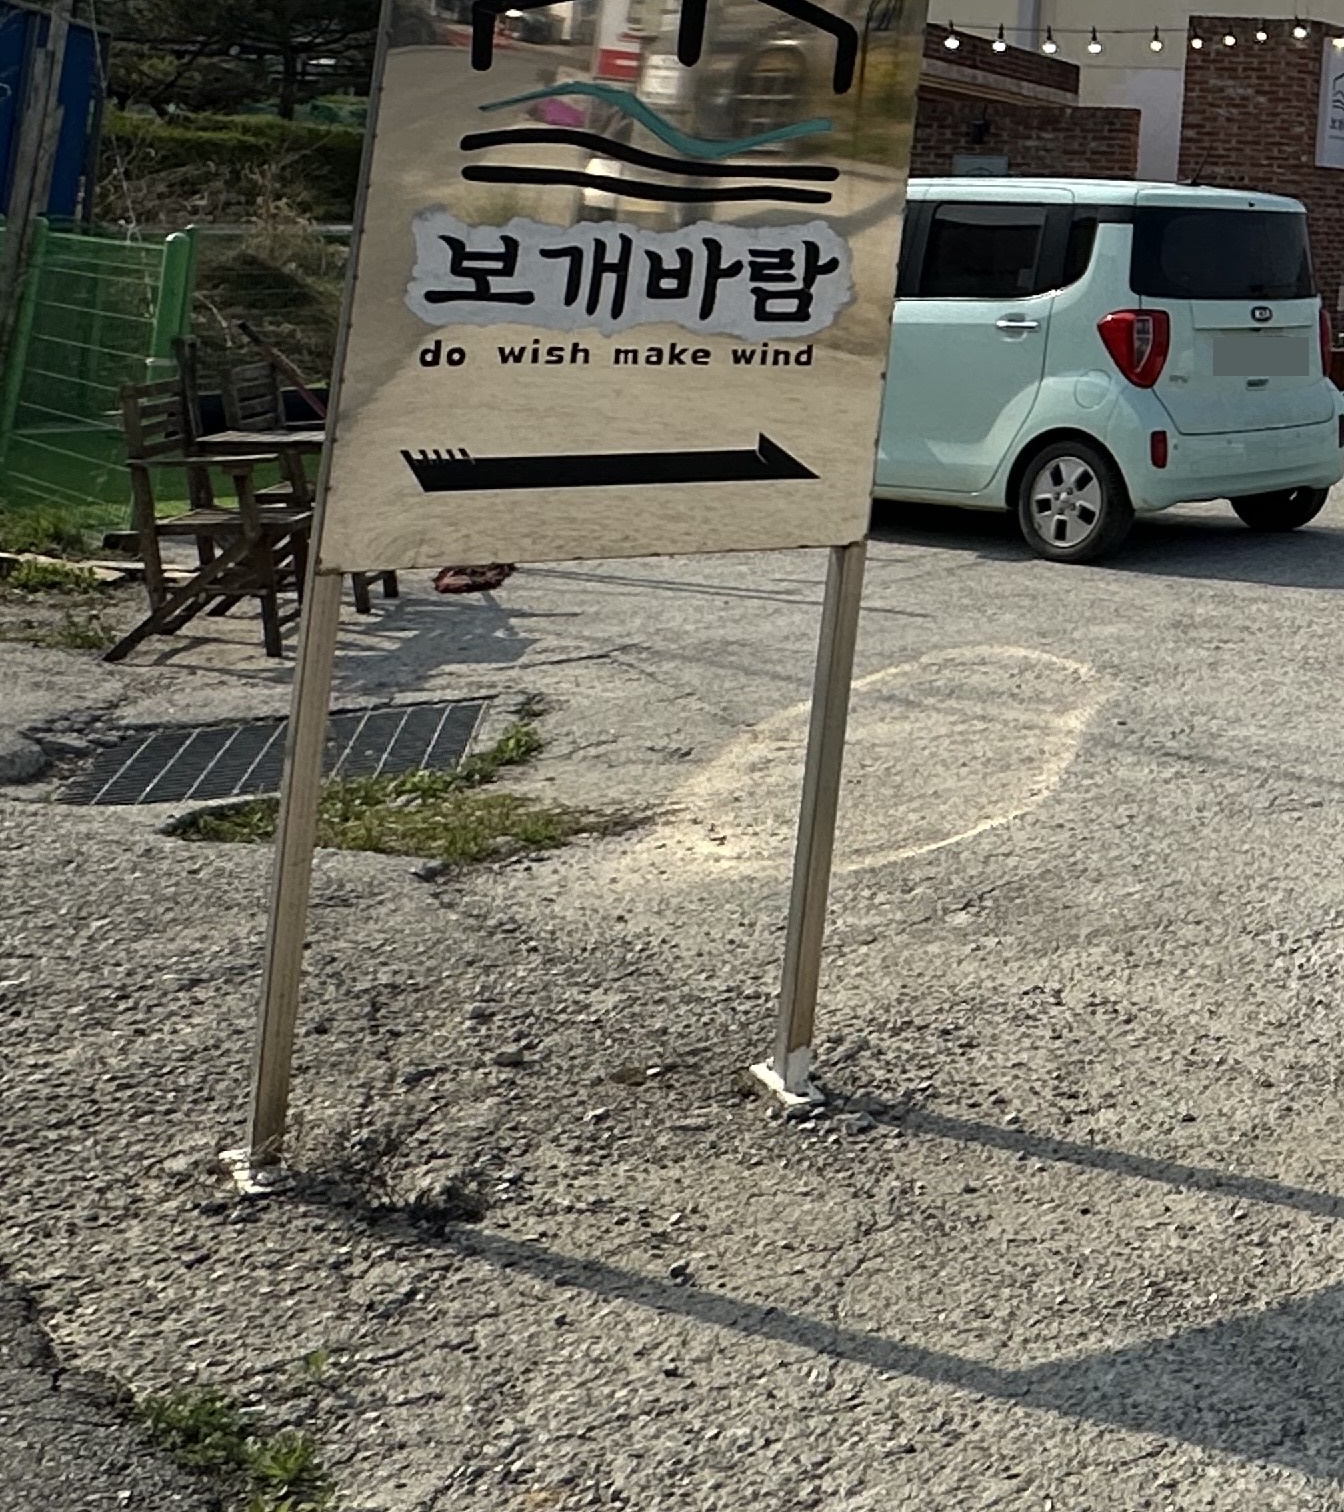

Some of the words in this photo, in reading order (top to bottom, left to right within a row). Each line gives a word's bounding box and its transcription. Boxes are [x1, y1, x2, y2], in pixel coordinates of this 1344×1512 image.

[424, 233, 840, 323] 보개바람
[419, 340, 466, 368] do
[498, 339, 591, 365] wish
[613, 343, 712, 366] make
[732, 342, 814, 367] wind
